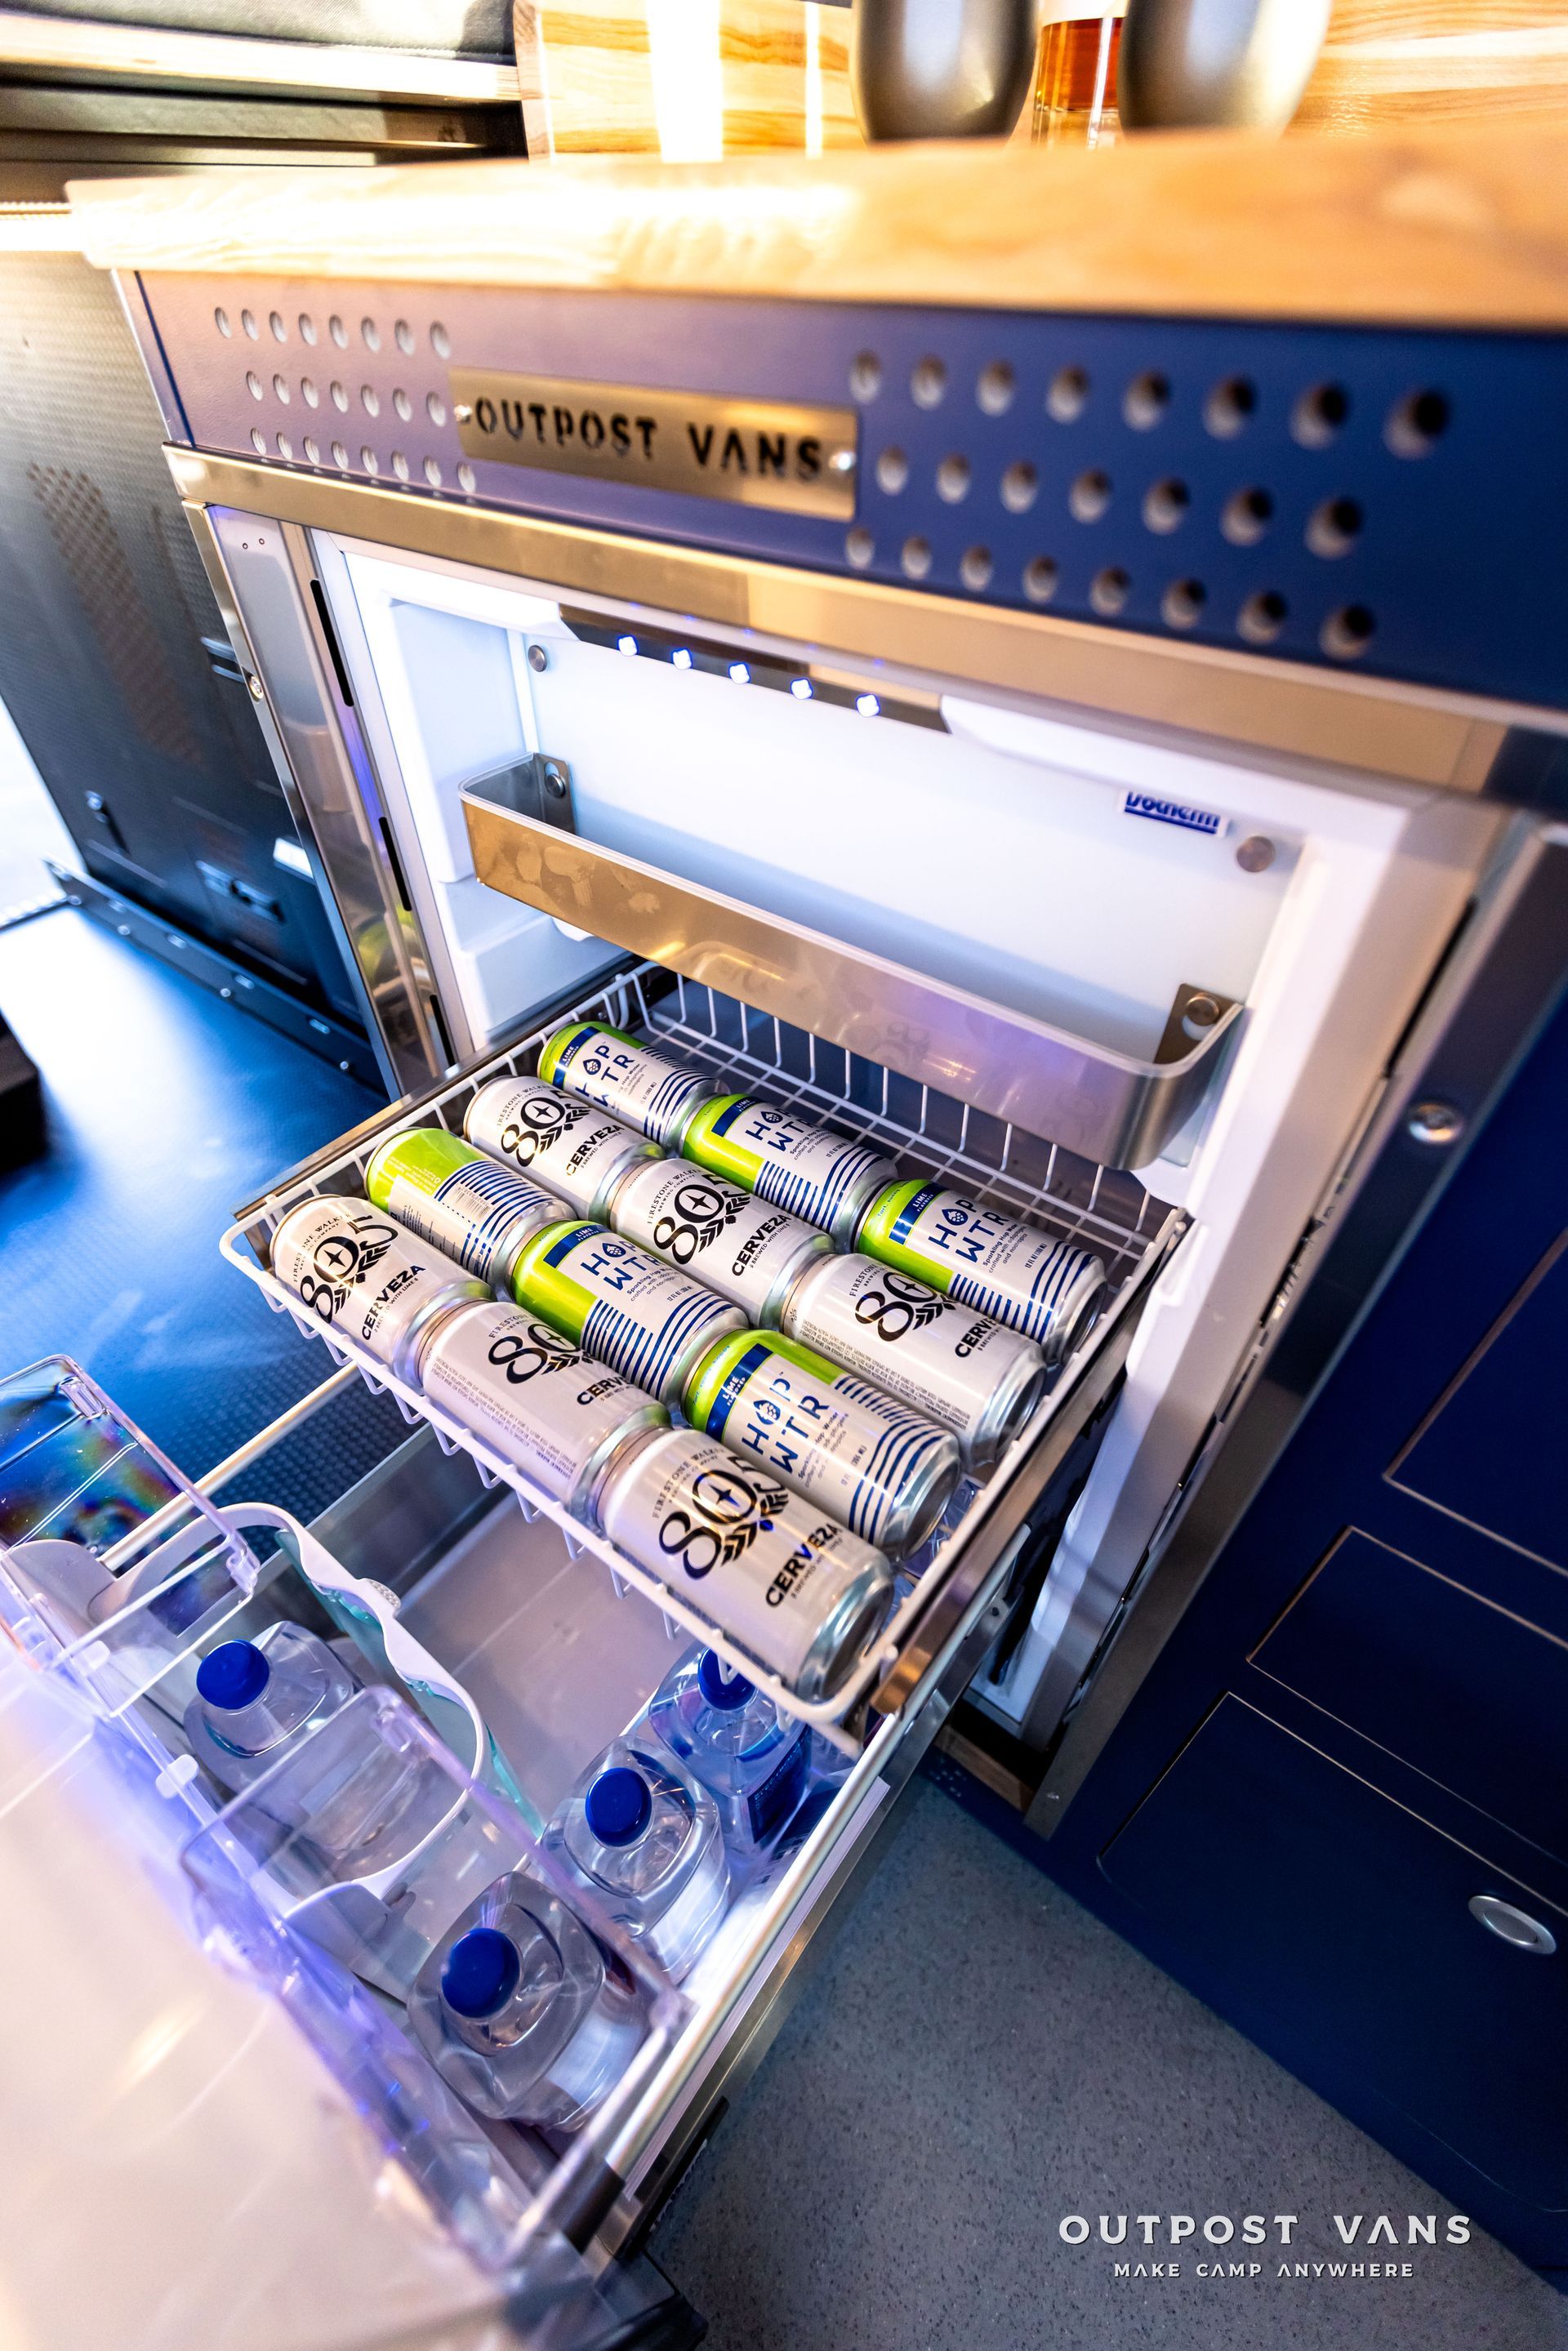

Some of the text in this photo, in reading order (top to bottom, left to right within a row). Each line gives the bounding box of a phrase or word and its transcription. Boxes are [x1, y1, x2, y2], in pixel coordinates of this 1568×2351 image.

[475, 396, 822, 482] OUTPOST VANS
[566, 1124, 625, 1177] CERVEZA
[912, 1192, 928, 1208] LIME
[575, 1227, 593, 1237] LIME
[732, 1214, 792, 1276] CERVEZA
[928, 1199, 978, 1249] HOP
[956, 1211, 1009, 1263] WTR
[751, 1242, 768, 1264] BREWED
[766, 1231, 778, 1244] WITH
[982, 1240, 1002, 1267] Sparkling
[999, 1230, 1009, 1242] Hop
[987, 1253, 1001, 1273] crafted
[1000, 1252, 1012, 1264] and
[301, 1215, 399, 1324] 805
[626, 1274, 651, 1295] Sparkling
[362, 1265, 426, 1341] CERVEZA
[389, 1289, 403, 1305] WITH
[401, 1280, 413, 1291] LIME
[630, 1285, 647, 1302] crafted
[722, 1377, 739, 1400] LIME
[742, 1377, 791, 1455] HOP
[769, 1395, 830, 1474] WTR
[822, 1410, 839, 1431] Water
[658, 1456, 786, 1580] 805
[766, 1524, 842, 1607] CERVEZA
